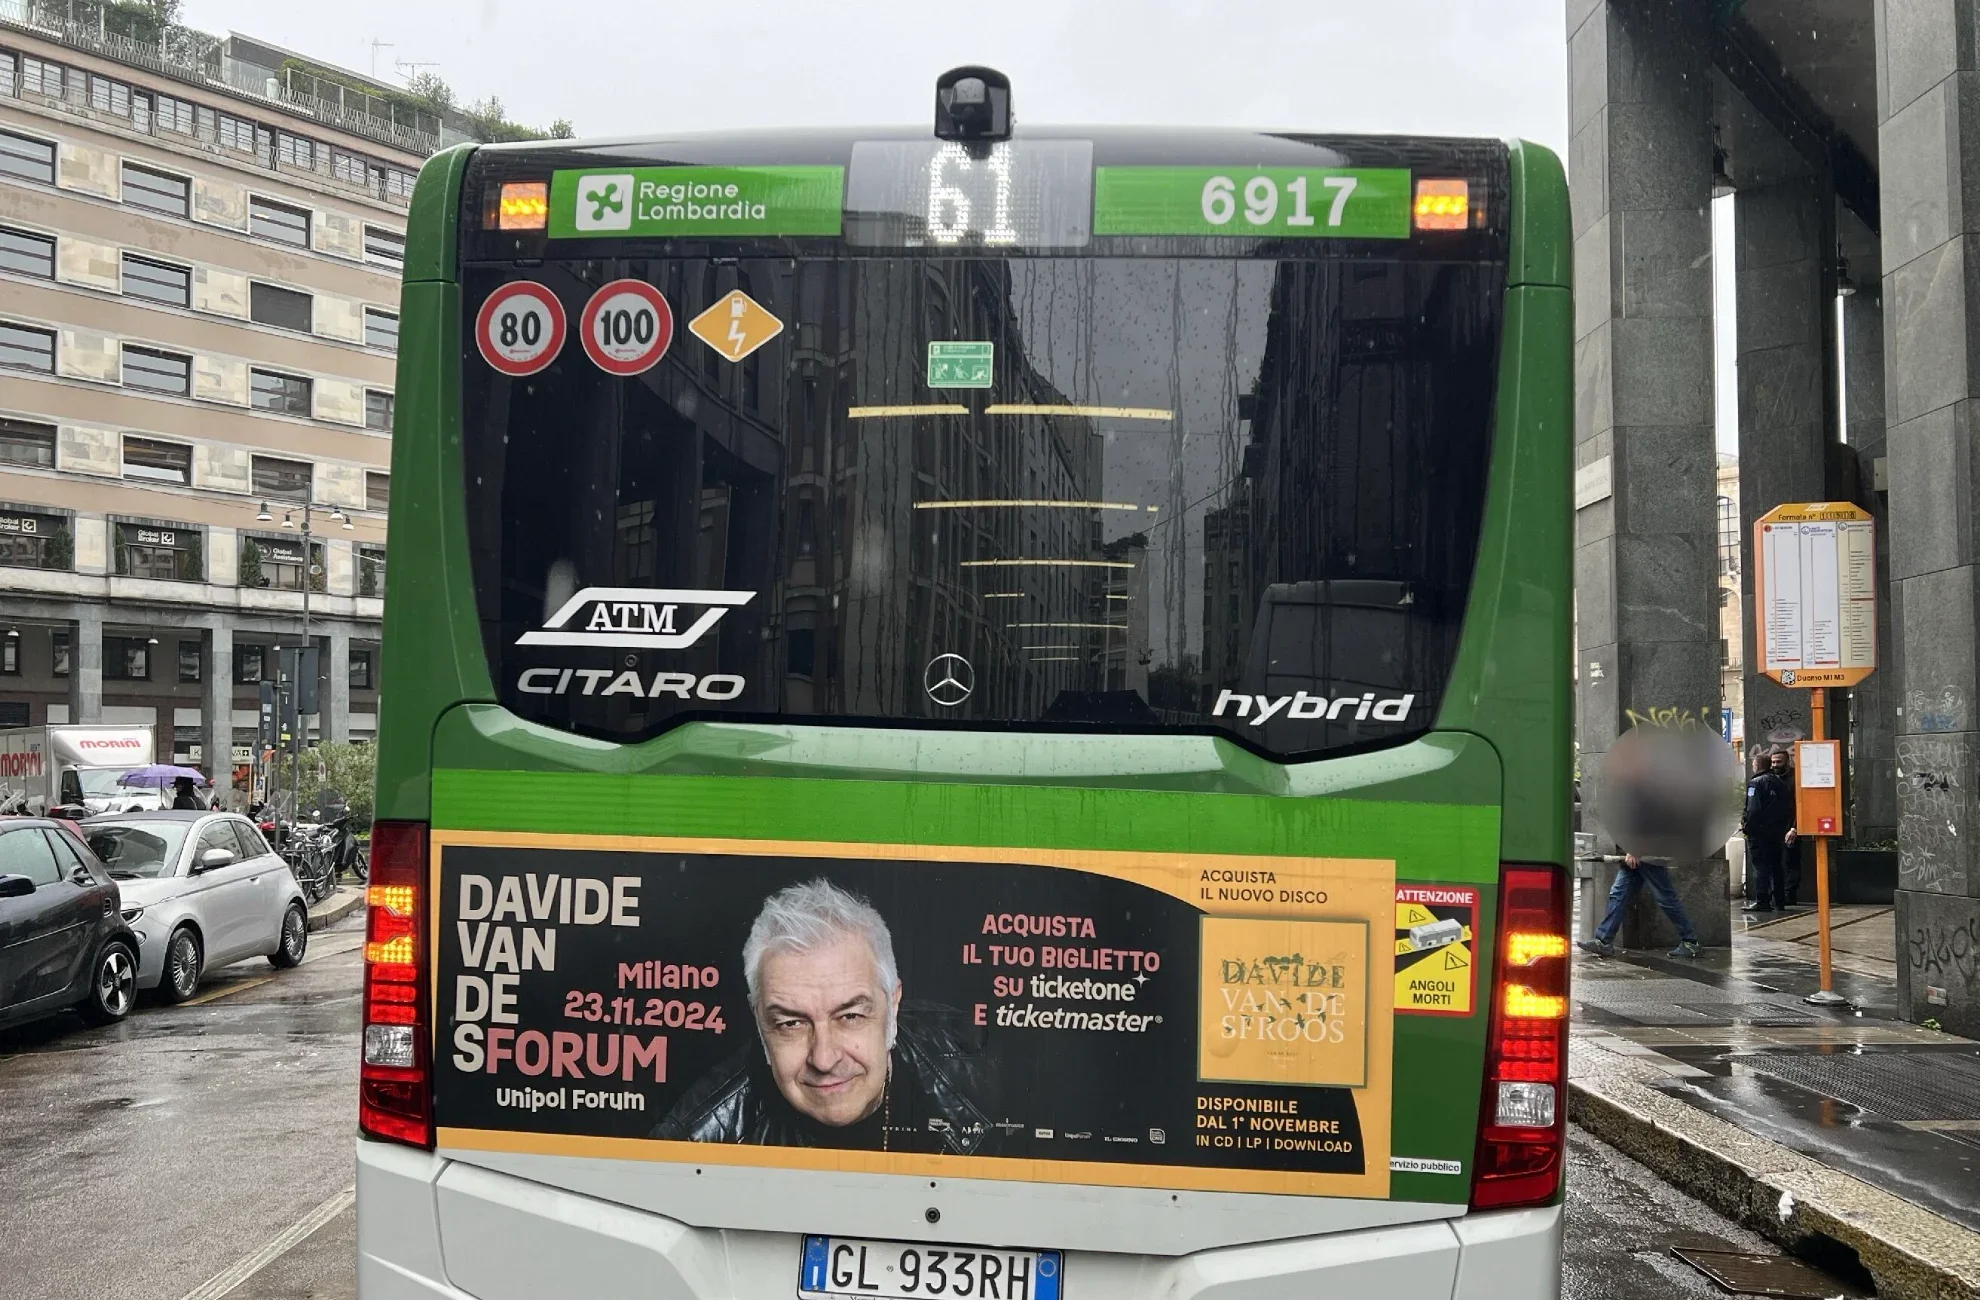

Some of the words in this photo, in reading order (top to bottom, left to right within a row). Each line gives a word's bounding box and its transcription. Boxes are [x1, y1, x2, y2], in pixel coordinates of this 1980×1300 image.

[639, 180, 739, 202] Regione
[928, 142, 1016, 243] 61
[1201, 176, 1358, 227] 6917
[638, 200, 766, 221] Lombardia
[500, 310, 541, 347] 80
[600, 308, 654, 346] 100
[272, 547, 292, 555] Global
[585, 602, 678, 634] ATM
[517, 667, 746, 701] CITARO
[1797, 674, 1822, 682] Duomo
[1212, 689, 1415, 726] hybrid
[1200, 869, 1276, 884] ACQUISTA
[459, 873, 642, 927] DAVIDE
[1200, 887, 1213, 900] IL
[1218, 888, 1274, 902] NUOVO
[1279, 890, 1328, 904] DISCO
[1396, 889, 1474, 904] ATTENZIONE
[981, 913, 1096, 938] ACQUISTA
[457, 921, 557, 973] VAN
[962, 943, 982, 965] IL
[988, 945, 1035, 967] TUO
[1041, 946, 1160, 972] BIGLIETTO
[618, 960, 720, 990] Milano
[993, 975, 1024, 998] SU
[1030, 973, 1136, 1001] ticketone
[1220, 958, 1345, 989] DAVIDE
[1409, 979, 1455, 992] ANGOLI
[455, 973, 520, 1025] DE
[564, 990, 726, 1035] 23.11.2024
[1220, 988, 1287, 1014] VAN
[1305, 991, 1345, 1017] DE
[1413, 993, 1451, 1005] MORTI
[974, 1003, 988, 1026] E
[1220, 1014, 1344, 1044] SFROOS
[452, 1023, 668, 1083] SFORUM
[496, 1086, 566, 1112] Unipol
[572, 1089, 645, 1111] Forum
[1197, 1096, 1298, 1114] DISPONIBILE
[1197, 1114, 1227, 1130] DAL
[1250, 1117, 1340, 1134] NOVEMBRE
[1196, 1135, 1210, 1147] IN
[1214, 1136, 1233, 1148] CD
[1246, 1137, 1262, 1149] LP
[1274, 1138, 1353, 1153] DOWNLOAD
[1390, 1160, 1419, 1169] ervizio
[1420, 1162, 1460, 1172] pubblico
[832, 1243, 879, 1291] GL
[899, 1248, 1030, 1300] 933RH
